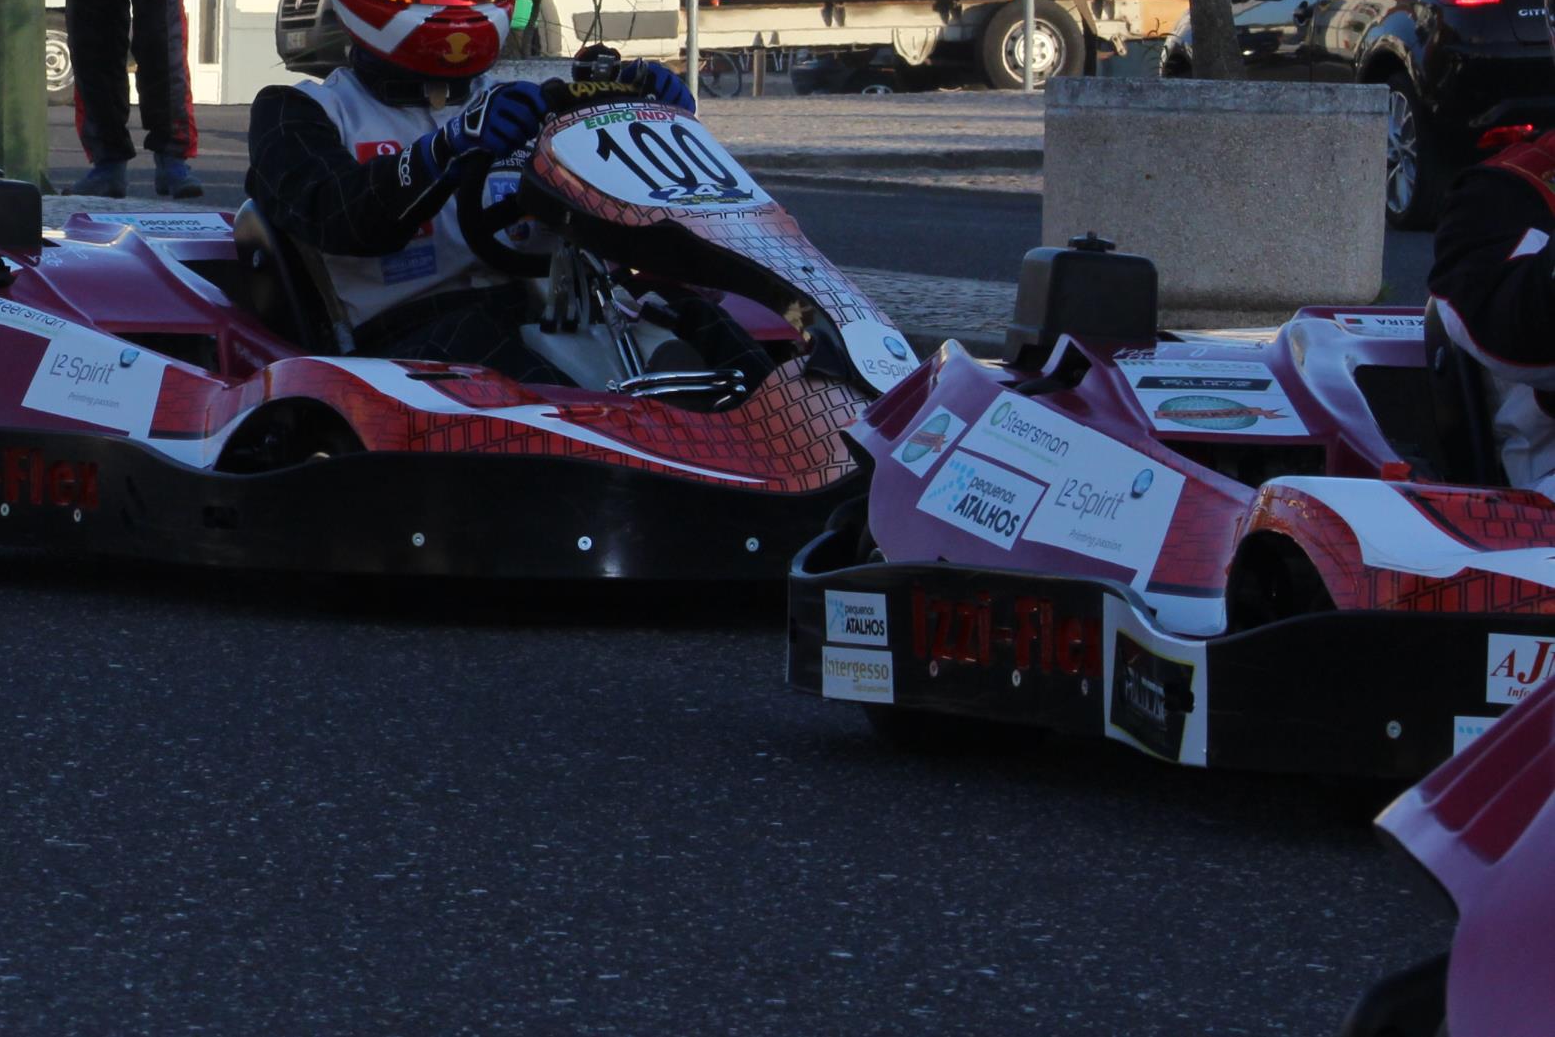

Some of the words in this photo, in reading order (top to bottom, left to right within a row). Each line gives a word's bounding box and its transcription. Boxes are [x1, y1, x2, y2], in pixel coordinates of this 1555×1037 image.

[584, 111, 678, 130] EUROINDY
[596, 122, 738, 192] 100
[1001, 411, 1070, 458] Steersman
[968, 474, 1017, 505] pequenos
[953, 493, 1021, 538] ATALHOS
[845, 617, 885, 638] ATALHOS
[825, 655, 889, 683] Intergesso
